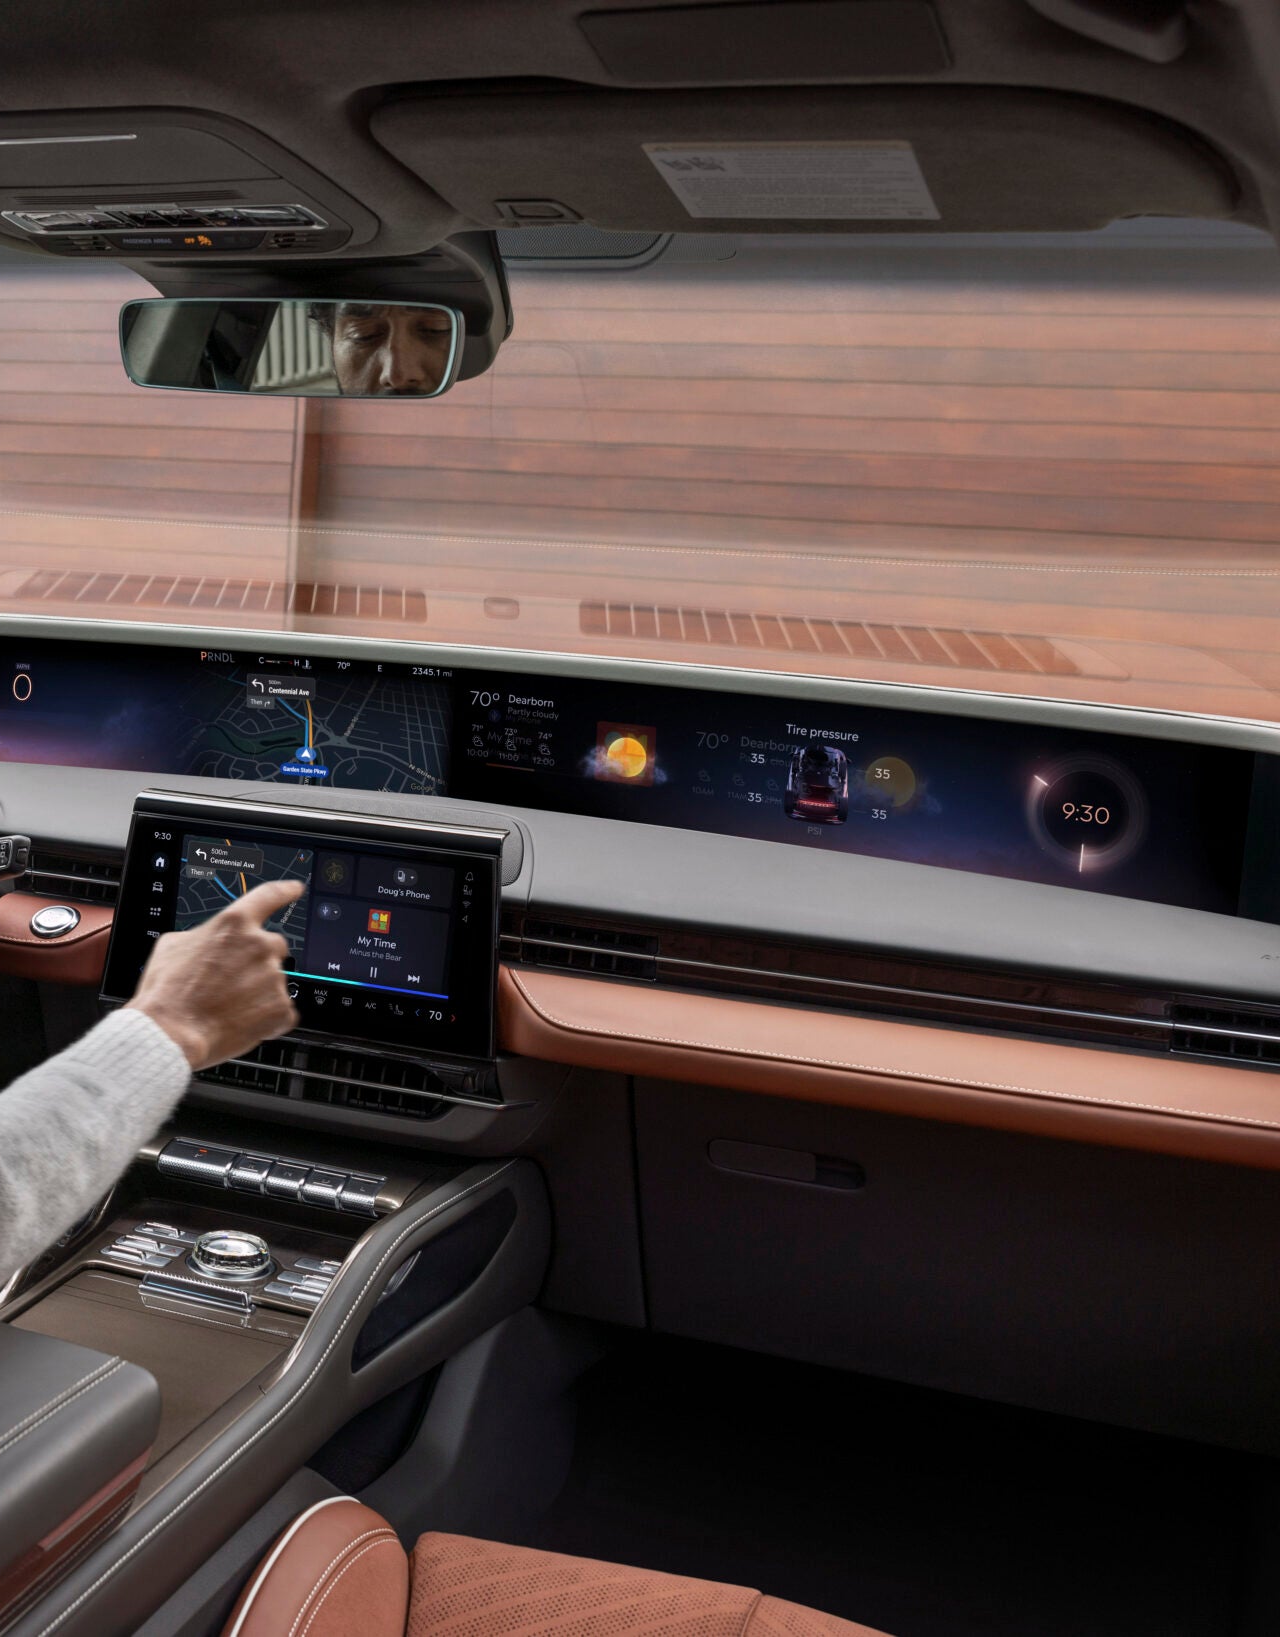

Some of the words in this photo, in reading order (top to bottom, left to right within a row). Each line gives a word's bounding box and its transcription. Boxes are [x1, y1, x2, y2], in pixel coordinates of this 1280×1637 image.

[200, 651, 236, 664] PRNDL
[258, 656, 266, 664] C
[294, 659, 300, 667] H
[377, 664, 383, 673] E
[412, 667, 440, 677] 2345.1
[13, 673, 32, 701] 0
[268, 687, 298, 696] Centennial
[298, 689, 310, 697] Ave
[508, 694, 554, 708] Dearborn
[507, 706, 532, 718] Partly
[532, 709, 559, 720] cloudy
[786, 723, 808, 736] Tire
[809, 728, 859, 742] pressure
[467, 748, 489, 758] 10:00
[499, 752, 520, 762] 11:00
[750, 752, 766, 764] 35
[532, 756, 555, 767] 12:00
[282, 765, 300, 773] Garden
[313, 768, 327, 776] Pkwy
[874, 767, 891, 780] 35
[410, 782, 434, 793] Google
[747, 791, 762, 803] 35
[871, 808, 887, 820] 35
[1062, 802, 1110, 825] 9:30
[154, 831, 172, 841] 9:30
[807, 826, 822, 837] PSI
[210, 847, 229, 856] 500m
[209, 856, 242, 867] Centennial
[242, 861, 255, 870] Ave
[190, 868, 205, 876] Then
[377, 885, 404, 898] Doug's
[405, 889, 431, 900] Phone
[357, 935, 372, 948] My
[373, 937, 397, 949] Time
[349, 947, 371, 958] Minus
[371, 951, 385, 960] the
[385, 952, 403, 962] Bear
[313, 988, 329, 997] MAX
[365, 1001, 377, 1010] A/C
[428, 1010, 443, 1021] 70
